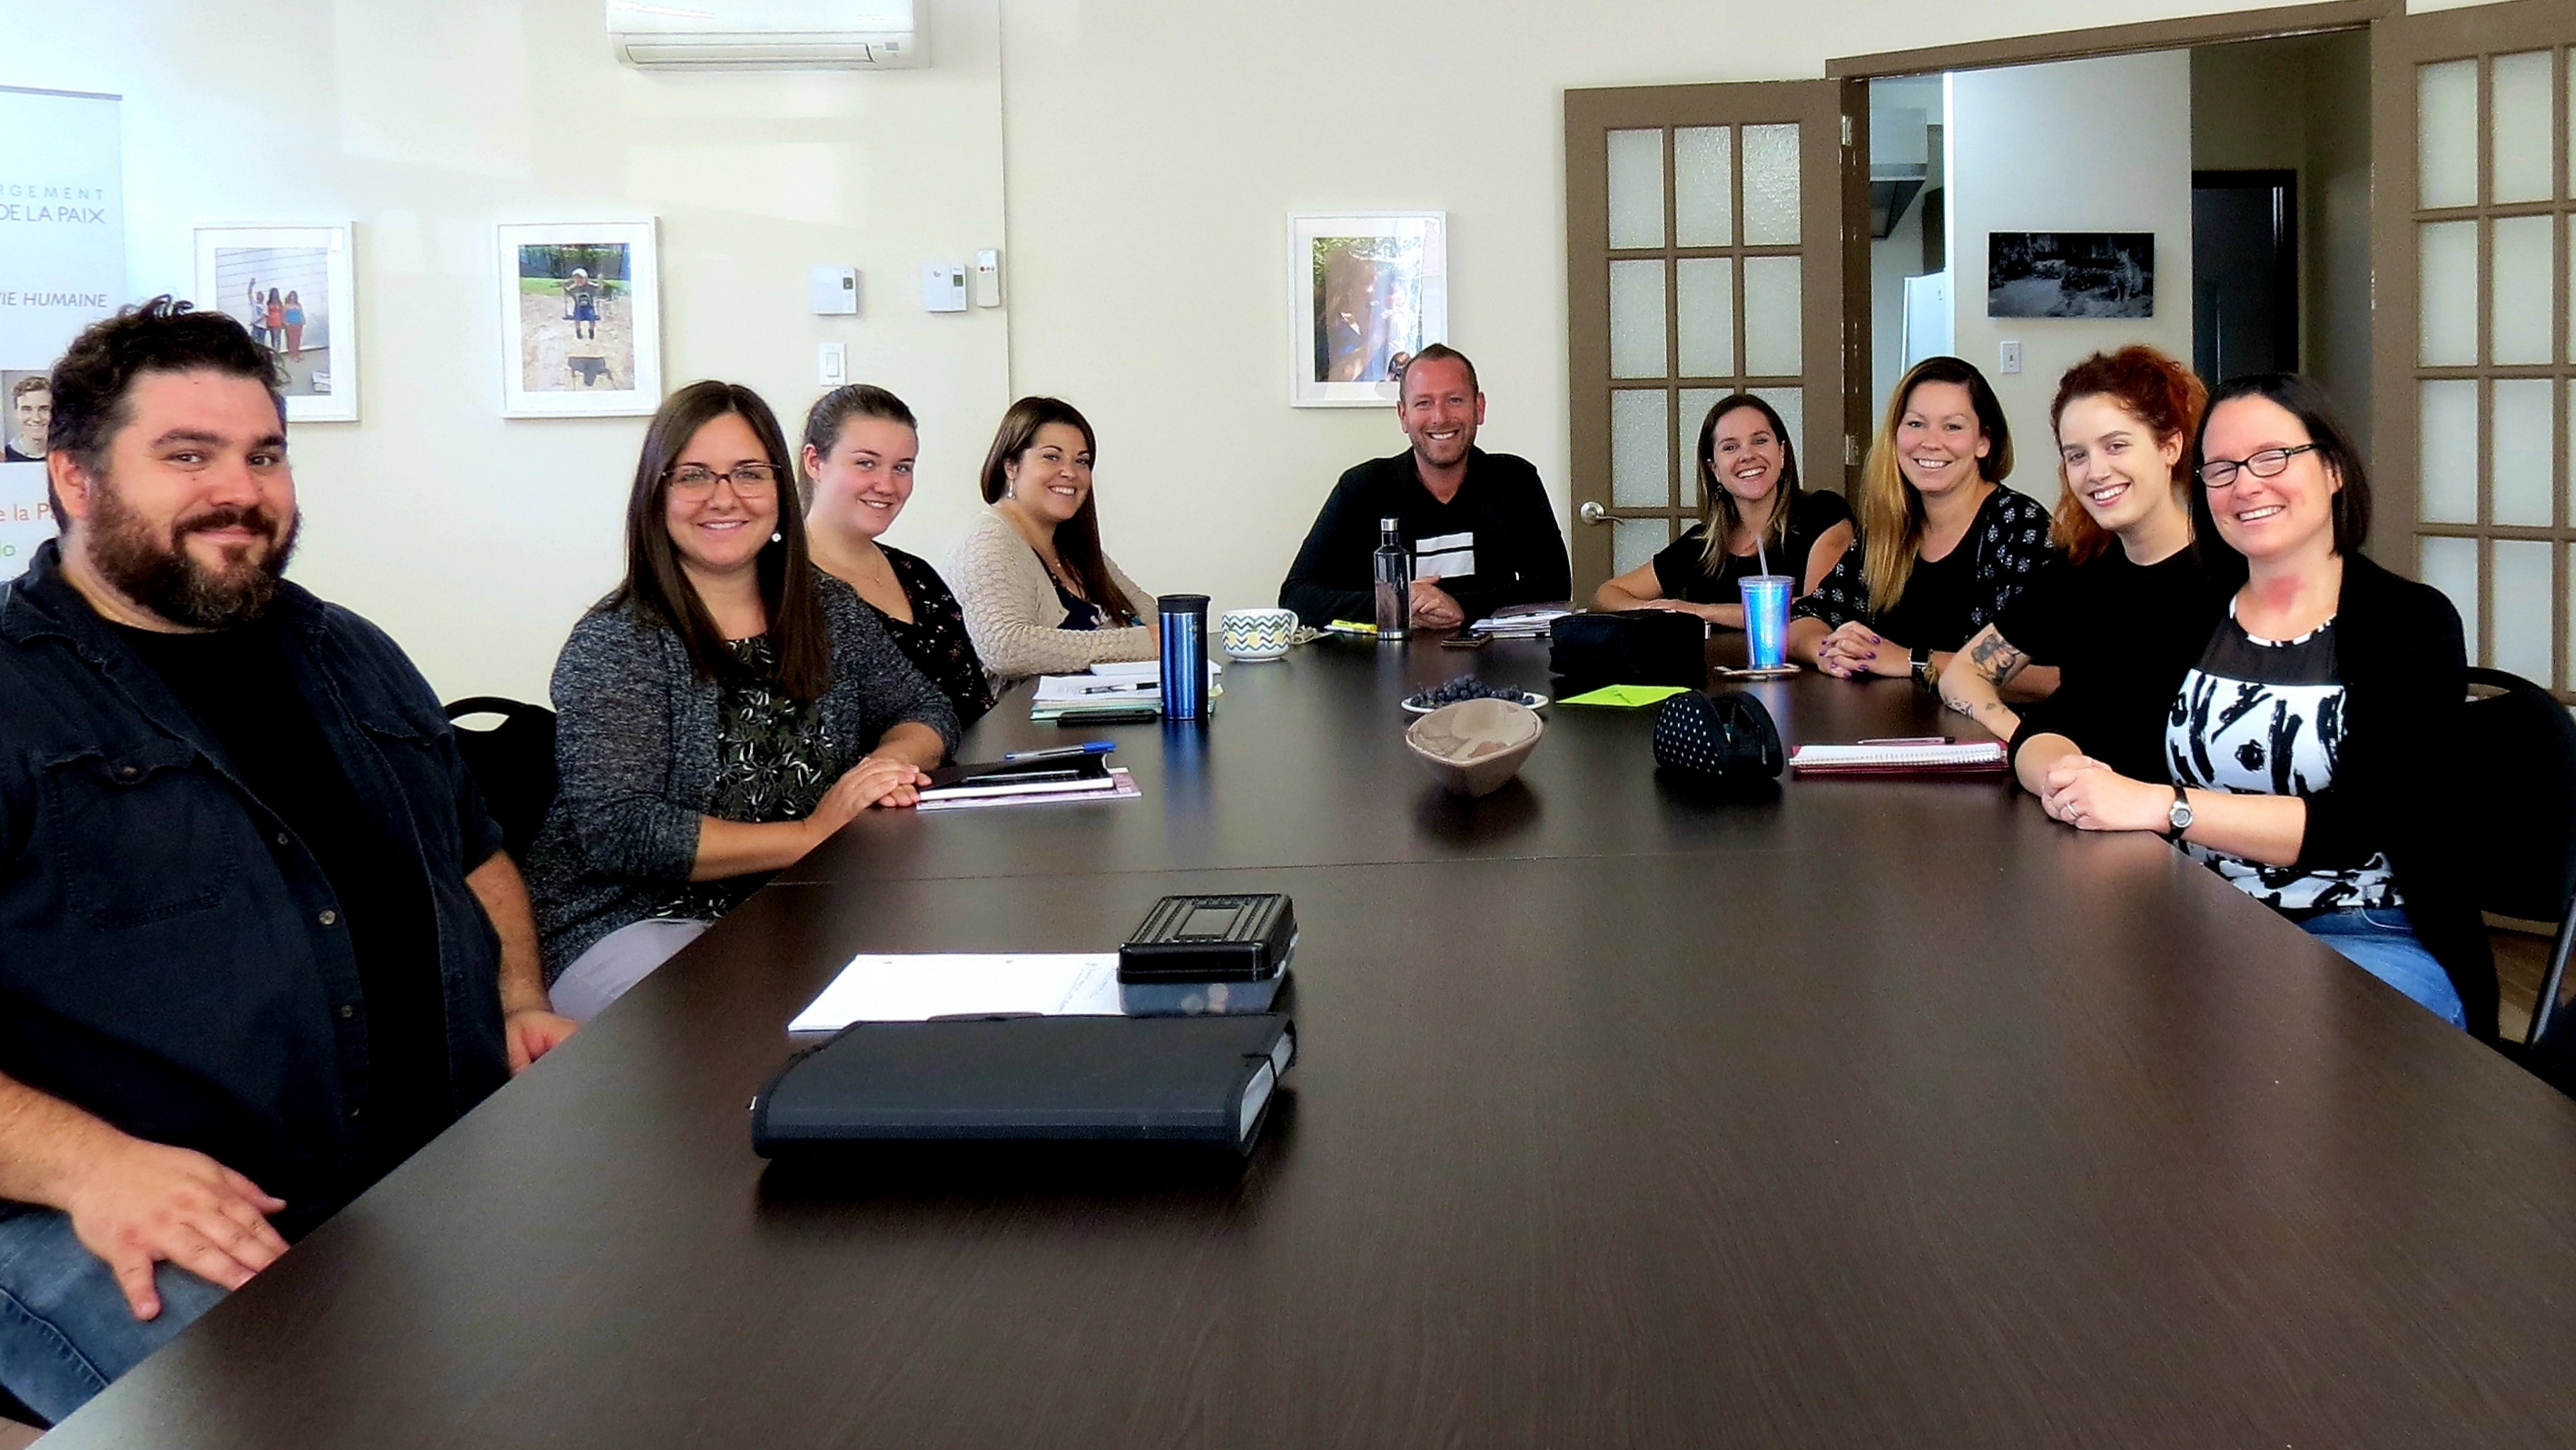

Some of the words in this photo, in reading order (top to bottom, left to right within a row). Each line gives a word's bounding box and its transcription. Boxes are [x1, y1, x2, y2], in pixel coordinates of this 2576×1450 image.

[0, 203, 21, 221] DE
[26, 205, 54, 222] LA
[58, 206, 105, 224] PAIX
[0, 291, 17, 306] IE
[24, 291, 108, 308] HUMAINE
[14, 504, 30, 521] la
